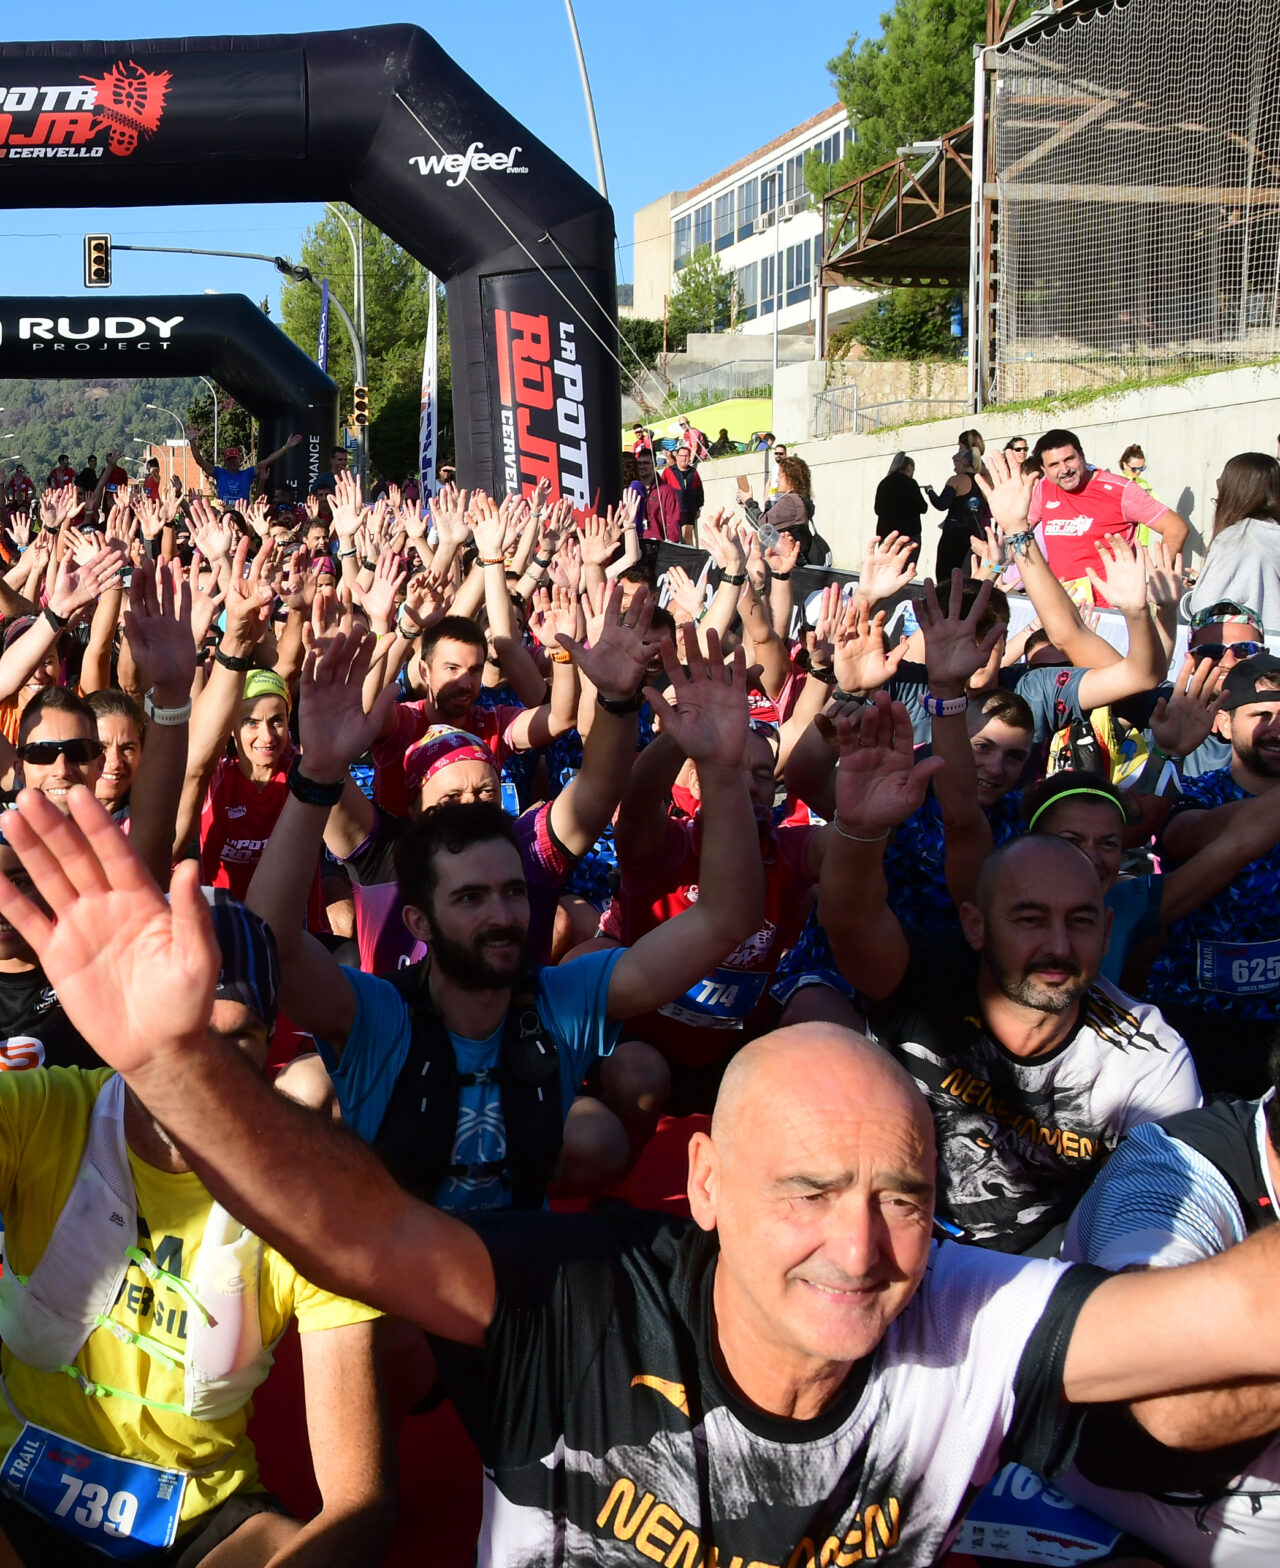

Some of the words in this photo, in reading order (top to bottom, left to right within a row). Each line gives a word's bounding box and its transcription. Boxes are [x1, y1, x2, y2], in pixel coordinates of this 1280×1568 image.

[9, 147, 104, 158] CERVELLO
[408, 141, 523, 187] wefeel
[506, 166, 529, 174] events
[18, 316, 184, 340] RUDY
[32, 342, 171, 351] PROJECT
[553, 360, 590, 513] POTA
[236, 838, 269, 849] POT
[695, 980, 740, 1007] 774
[8, 1440, 40, 1478] TRAIL
[53, 1473, 139, 1539] 739
